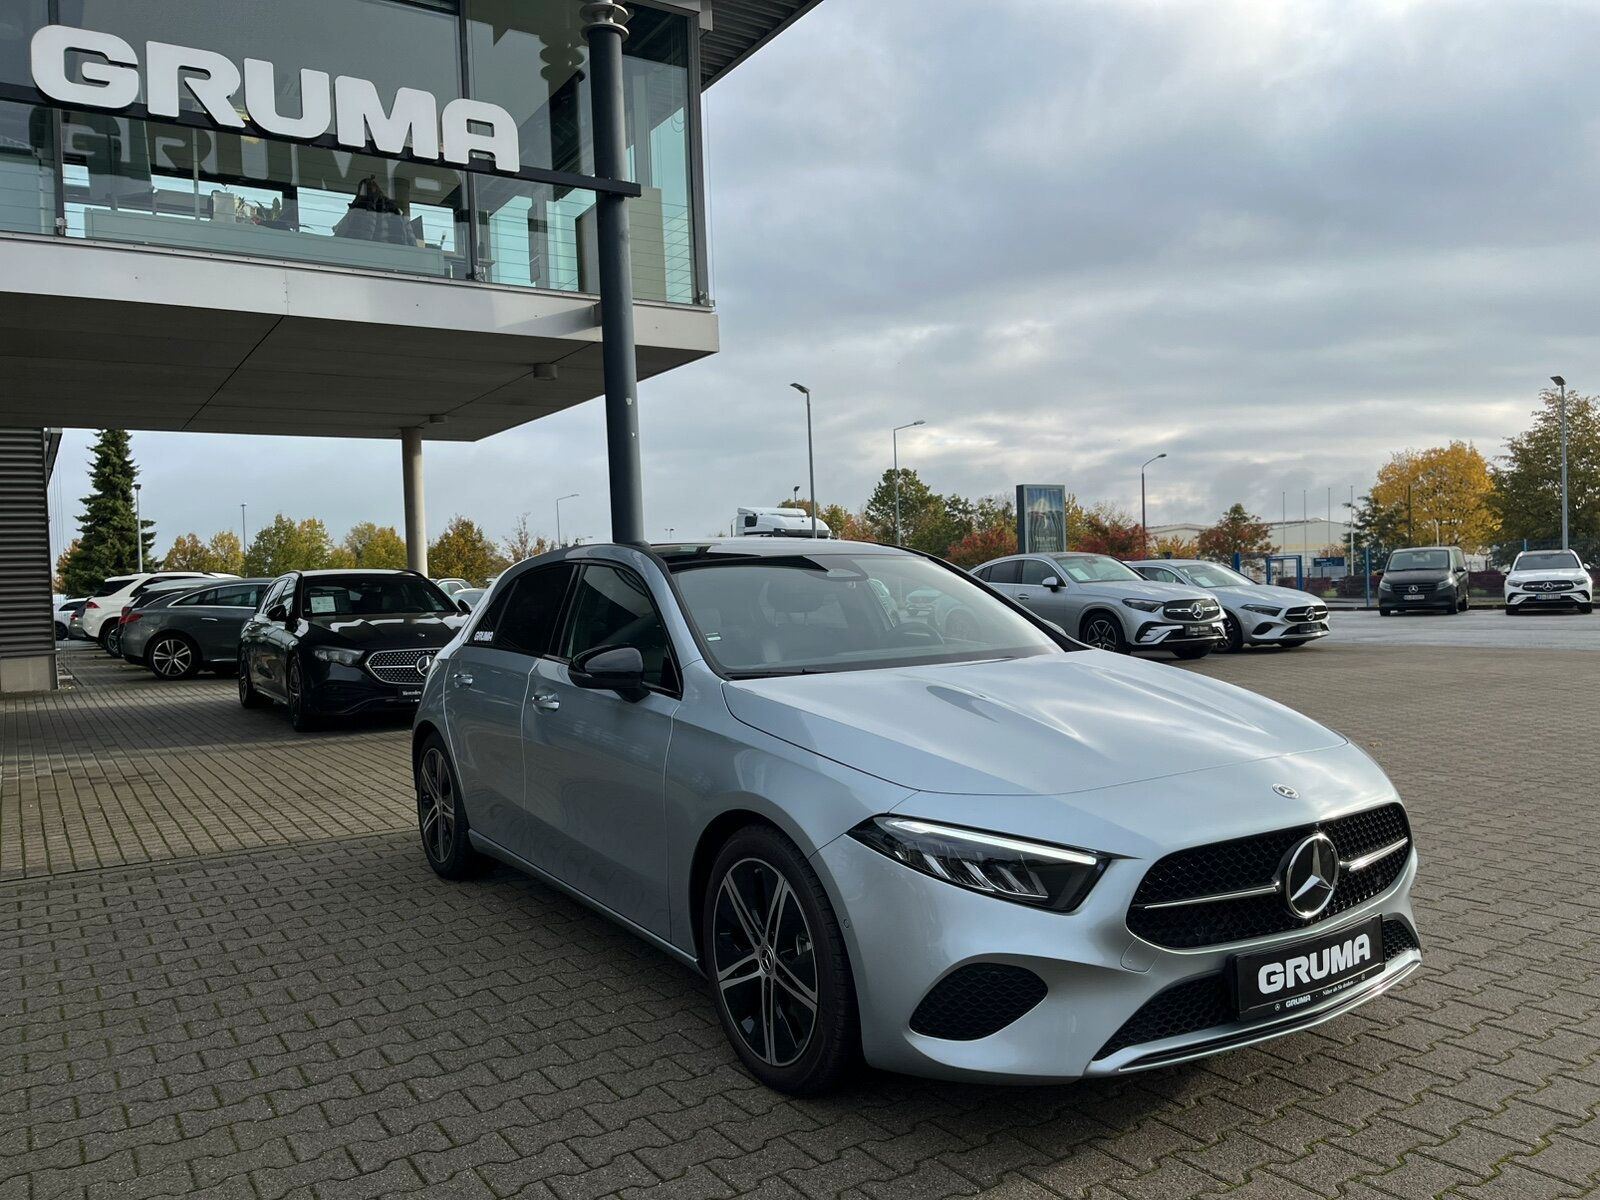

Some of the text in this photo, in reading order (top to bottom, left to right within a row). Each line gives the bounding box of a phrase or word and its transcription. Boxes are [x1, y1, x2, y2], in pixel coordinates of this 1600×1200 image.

[31, 24, 520, 172] GRUMA
[474, 631, 493, 642] GRUMA
[1257, 933, 1371, 995] GRUMA
[1285, 994, 1311, 1008] GRUMA
